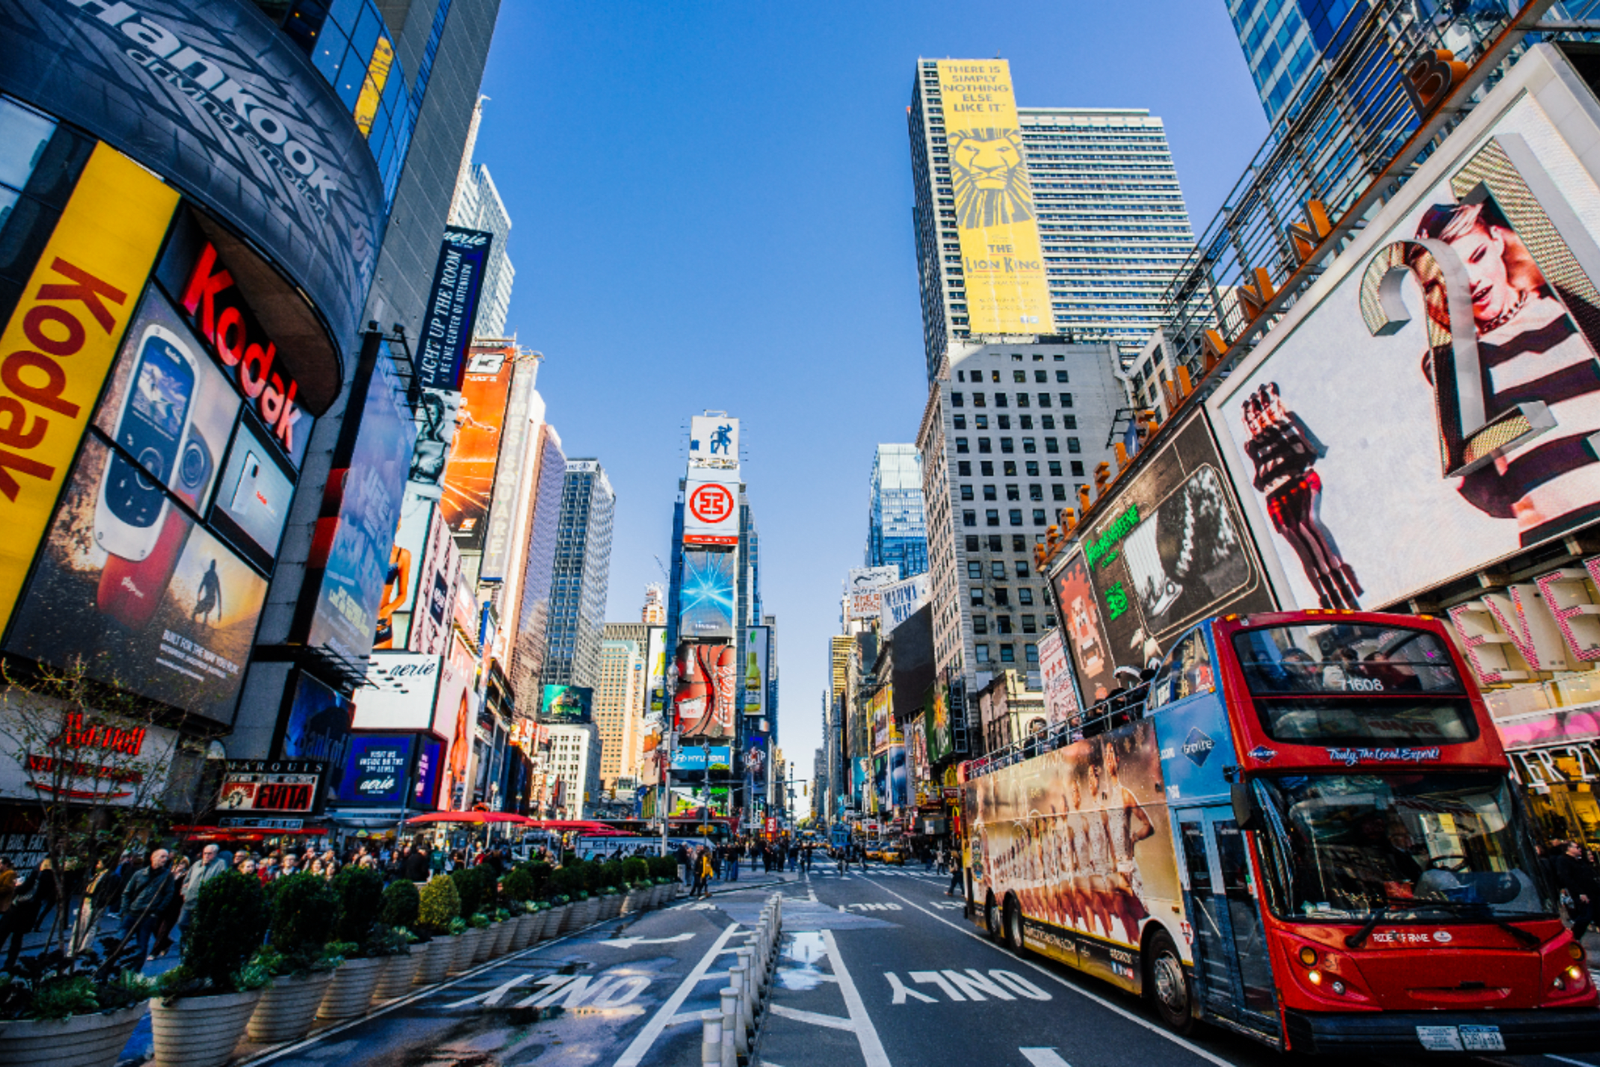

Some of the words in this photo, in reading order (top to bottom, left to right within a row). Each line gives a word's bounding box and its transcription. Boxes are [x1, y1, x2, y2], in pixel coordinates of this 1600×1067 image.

[951, 74, 997, 84] SIMPLY
[989, 65, 1001, 74] IS
[943, 83, 1009, 92] NOTHING
[962, 93, 993, 102] ELSE
[953, 103, 984, 113] LIKE
[126, 48, 243, 138] driving
[246, 134, 330, 222] emotion
[987, 244, 1014, 253] THE
[440, 249, 463, 289] ROOM
[965, 256, 1001, 273] LION
[1003, 256, 1041, 273] KING
[434, 287, 454, 317] THE
[446, 315, 462, 345] CENTER
[455, 263, 473, 304] ATTENTION
[429, 317, 446, 338] UP
[180, 241, 301, 453] Kodak
[421, 339, 442, 385] LIGHT
[508, 373, 532, 447] TIMES
[489, 454, 519, 555] SQUARE
[390, 659, 436, 677] aerie
[1340, 678, 1384, 691] 71608
[227, 761, 324, 772] MARQUIS
[255, 784, 310, 810] EVITA
[1372, 933, 1395, 943] RIDE
[1407, 933, 1431, 943] FAME
[883, 968, 1053, 1005] ONLY
